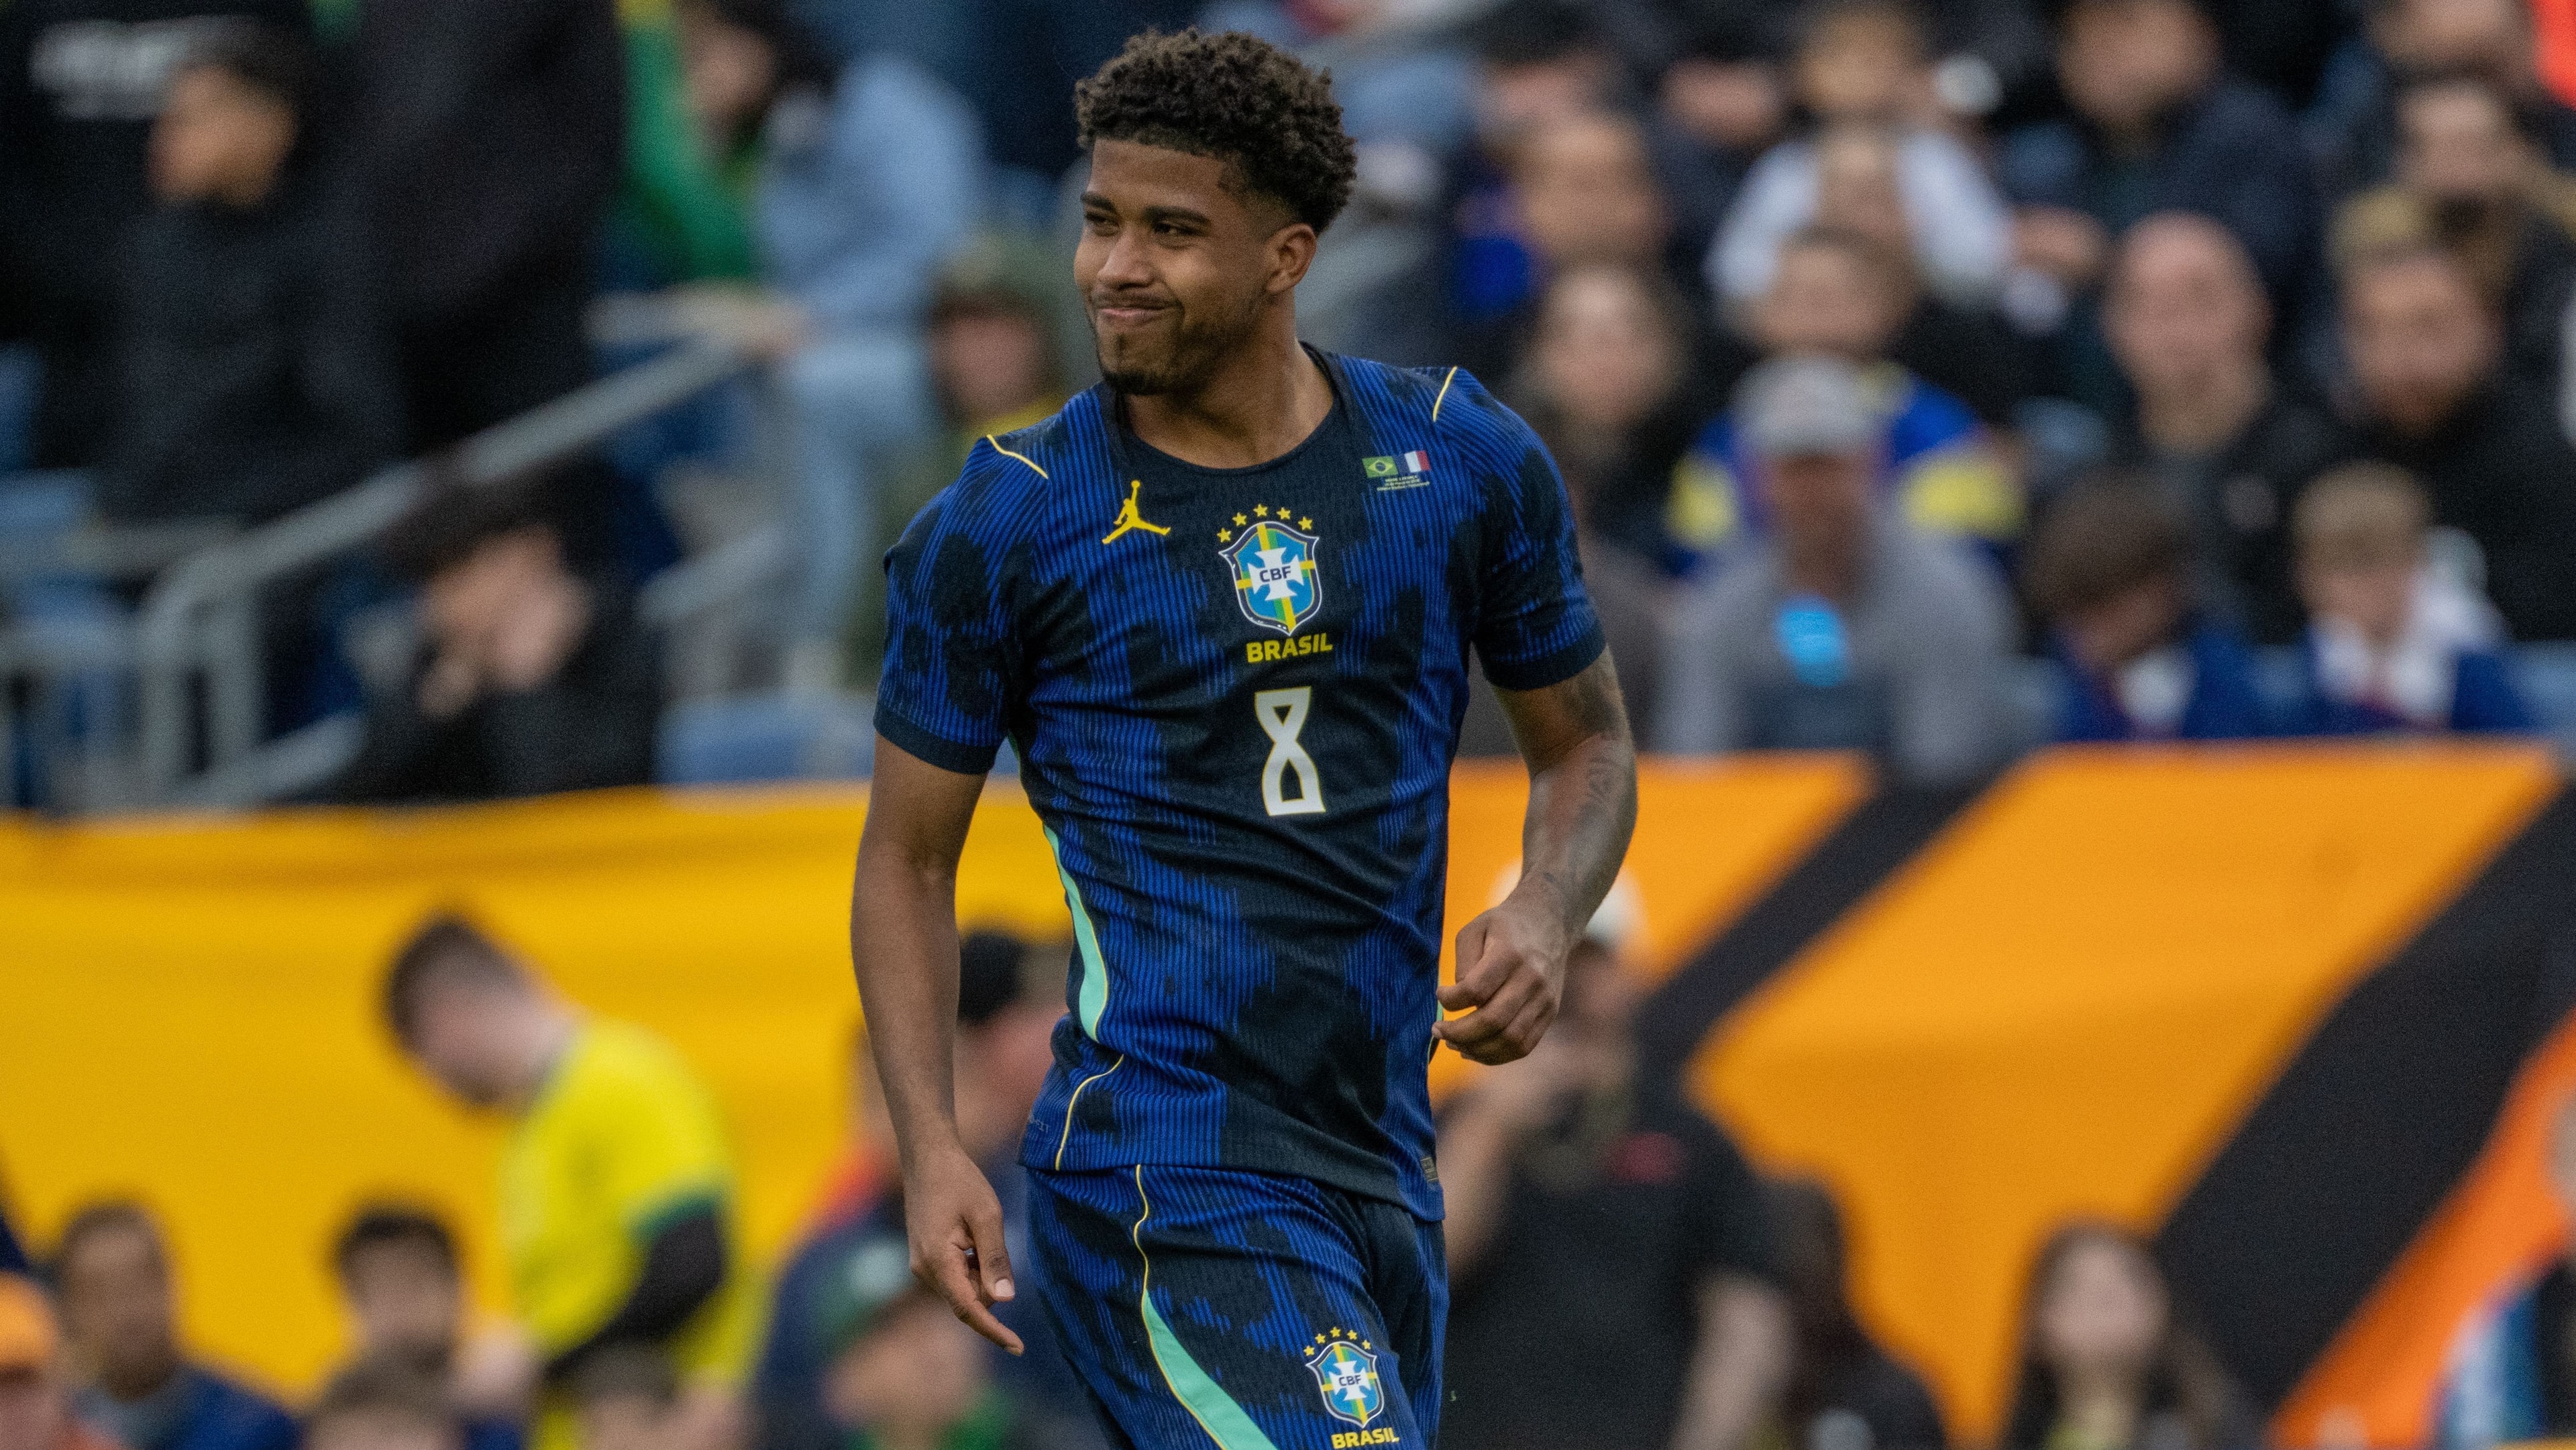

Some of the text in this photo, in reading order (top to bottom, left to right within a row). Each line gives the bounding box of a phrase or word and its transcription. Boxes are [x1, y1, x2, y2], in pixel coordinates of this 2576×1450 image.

[1259, 566, 1292, 582] CBF
[1246, 632, 1333, 663] BRASIL
[1254, 685, 1326, 817] 8
[1338, 1374, 1362, 1387] CBF
[1331, 1427, 1399, 1449] BRASIL
